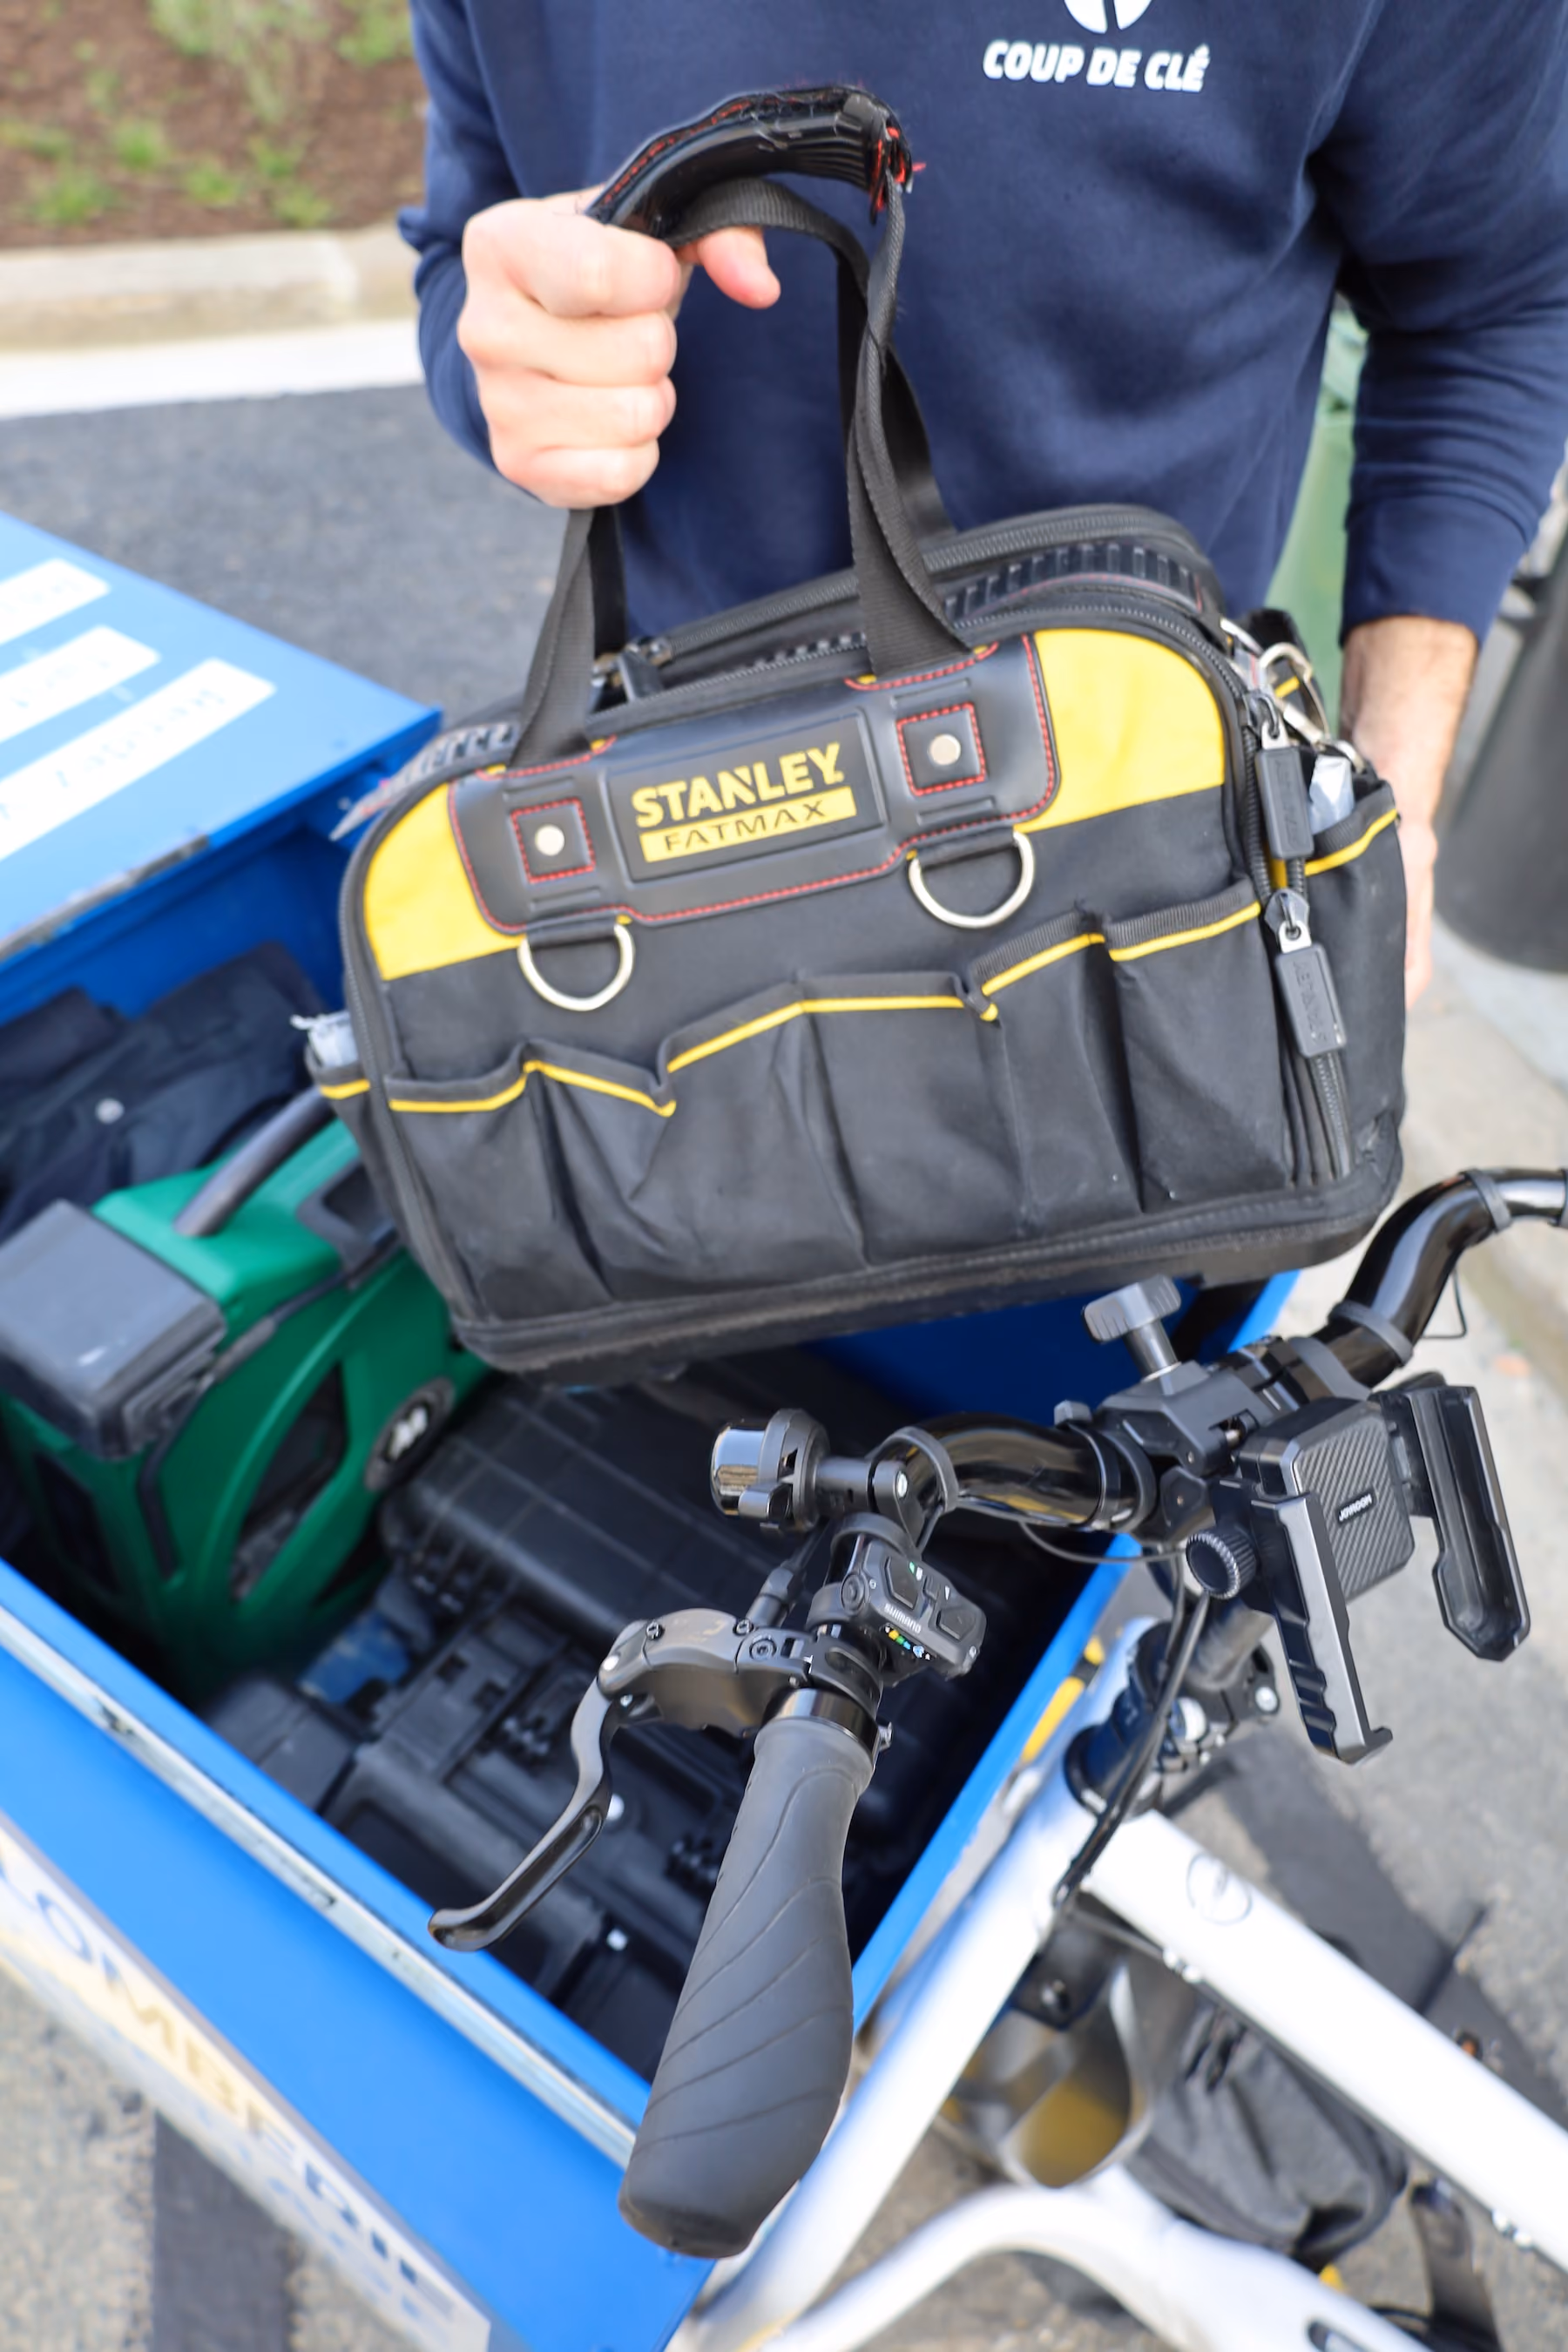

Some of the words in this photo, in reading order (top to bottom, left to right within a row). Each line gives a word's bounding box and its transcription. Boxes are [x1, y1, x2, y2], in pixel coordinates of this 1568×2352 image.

[983, 39, 1085, 83] COUP
[1086, 46, 1142, 88] DE
[1144, 44, 1210, 92] CLÉ
[632, 742, 841, 828] STANLEY
[664, 800, 825, 852] FATMAX
